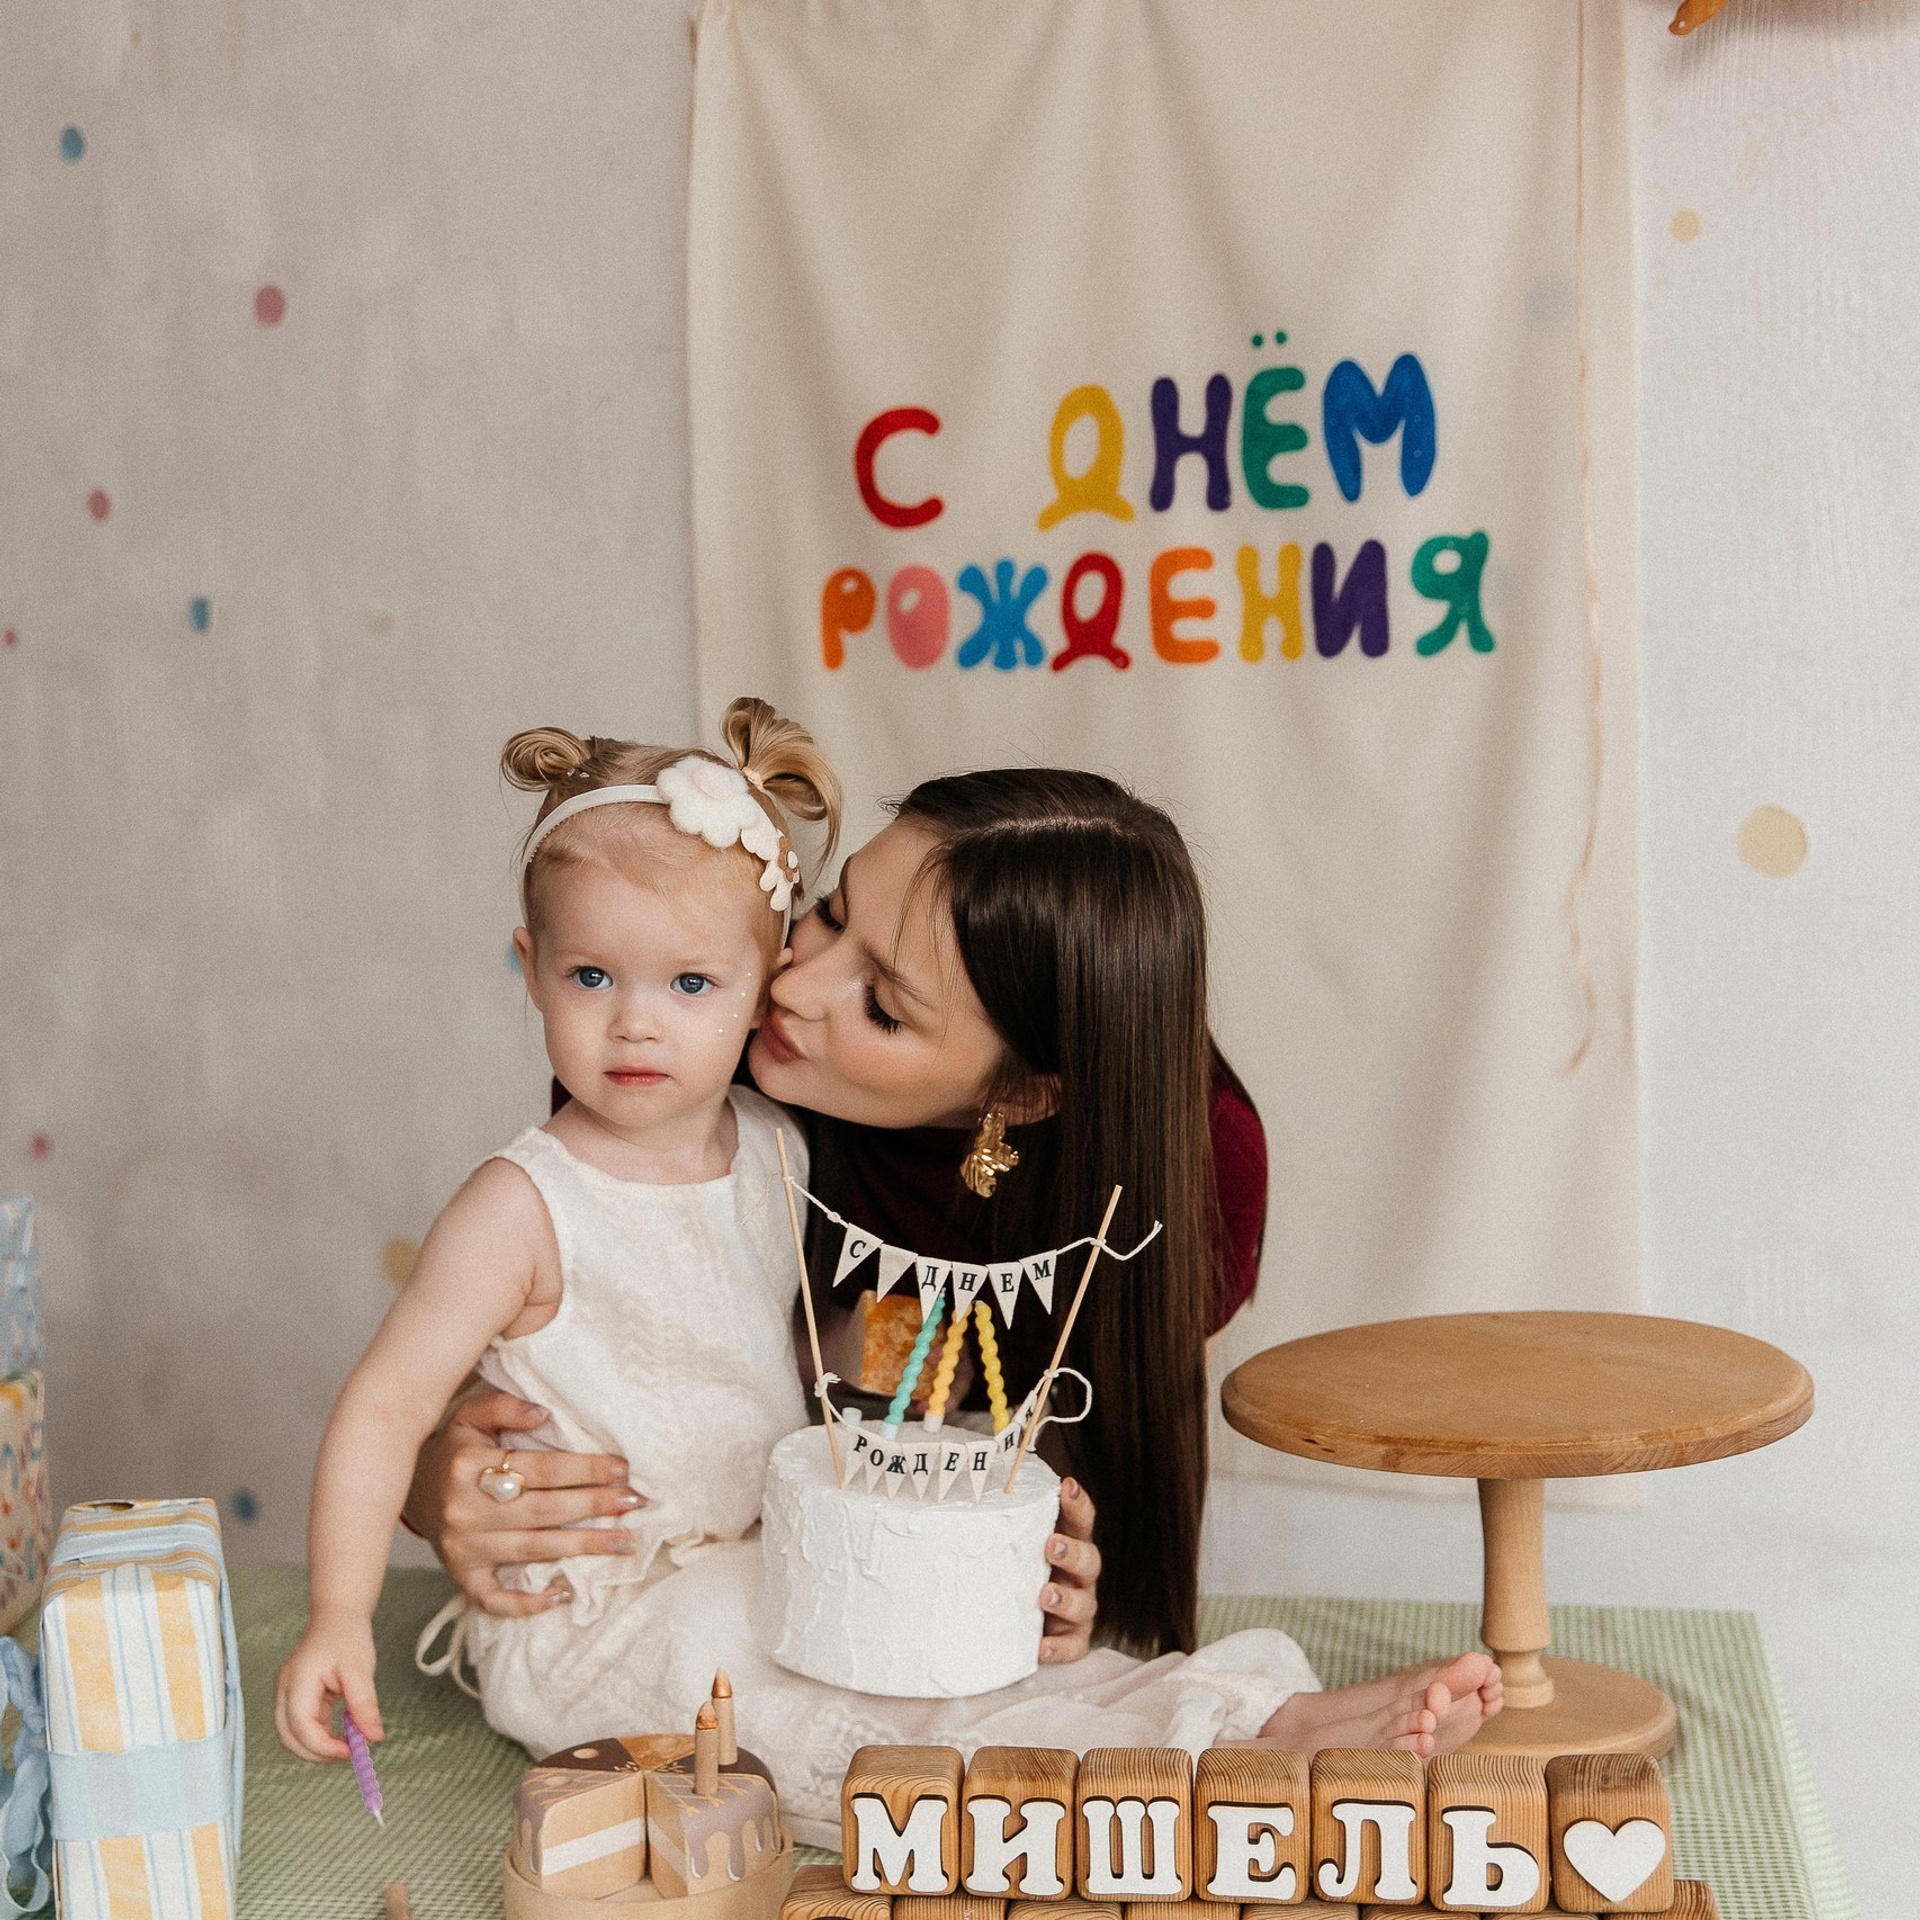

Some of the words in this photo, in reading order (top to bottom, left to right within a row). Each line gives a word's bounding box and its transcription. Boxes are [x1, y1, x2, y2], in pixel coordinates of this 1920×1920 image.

[853, 406, 944, 530] С
[1036, 330, 1437, 532] ДНЁМ
[820, 530, 1496, 673] РОЖДЕНИЯ
[849, 1239, 867, 1259] С
[921, 1259, 1052, 1293] ДНЕМ
[851, 1797, 1541, 1907] МИШЕЛЬ
